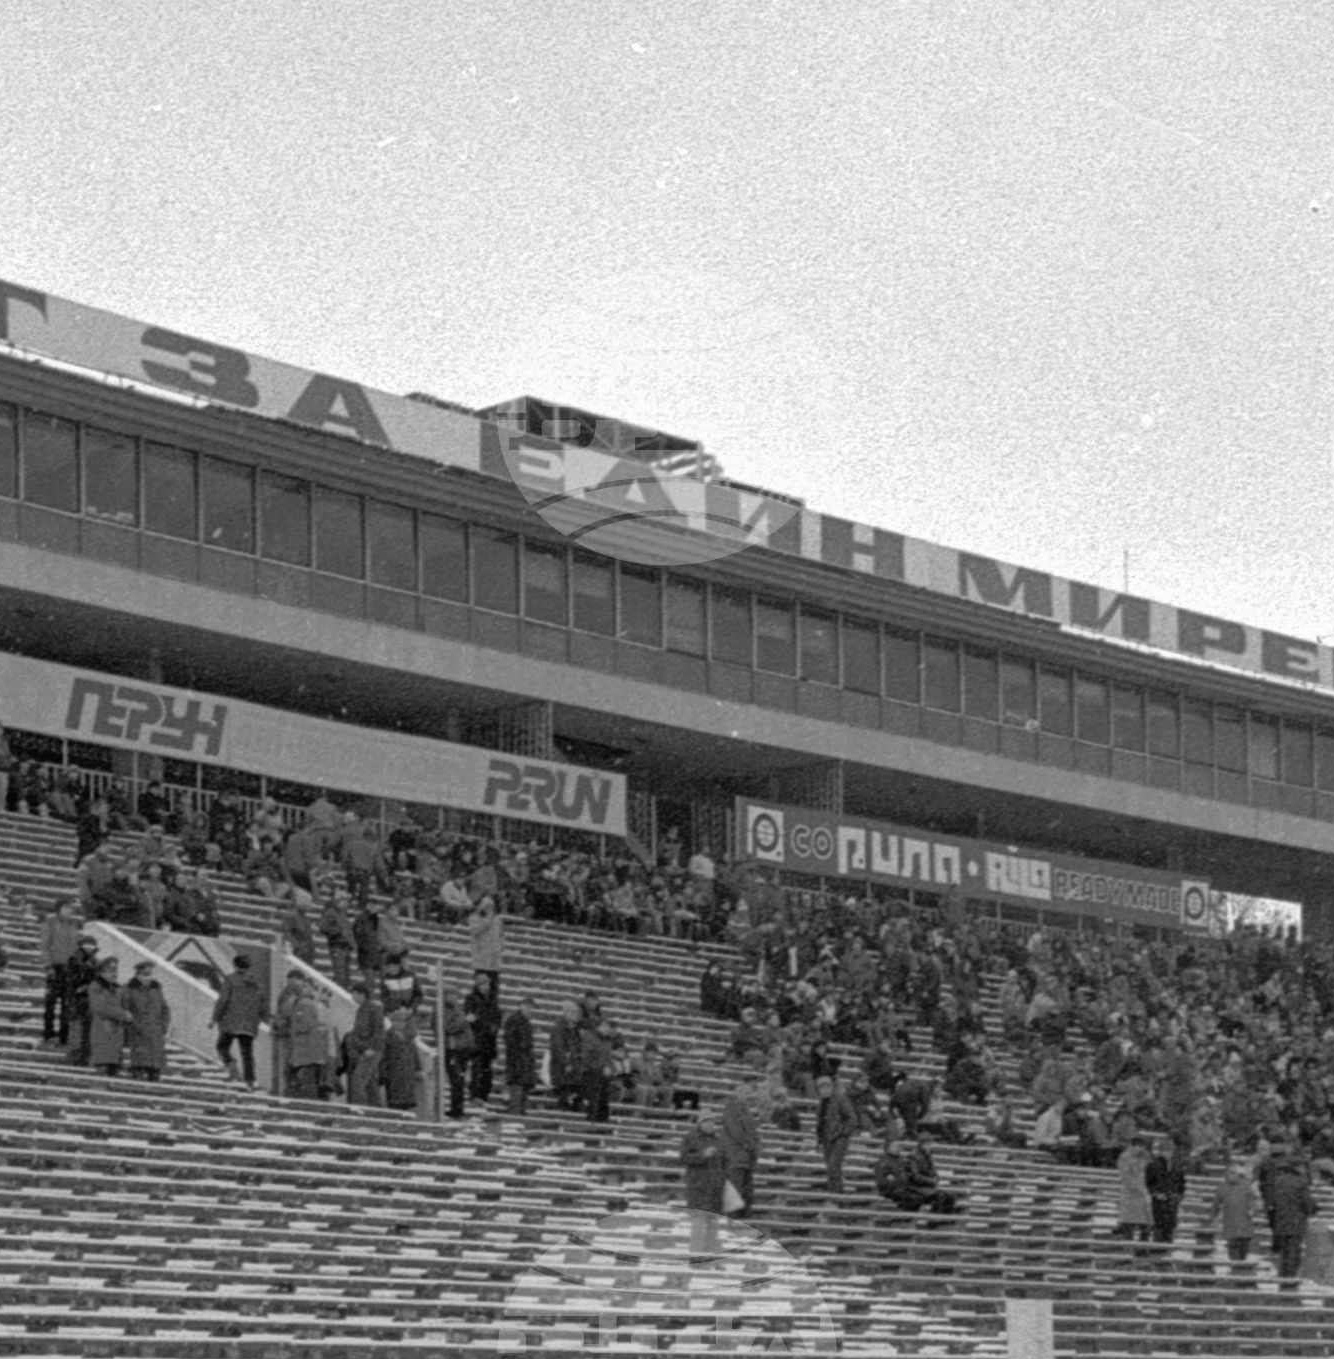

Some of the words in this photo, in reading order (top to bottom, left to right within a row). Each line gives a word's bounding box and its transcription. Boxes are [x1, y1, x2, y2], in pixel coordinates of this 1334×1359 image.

[139, 325, 395, 451] ЗА
[67, 676, 228, 756] ПЕРУН
[482, 757, 613, 825] PERUN
